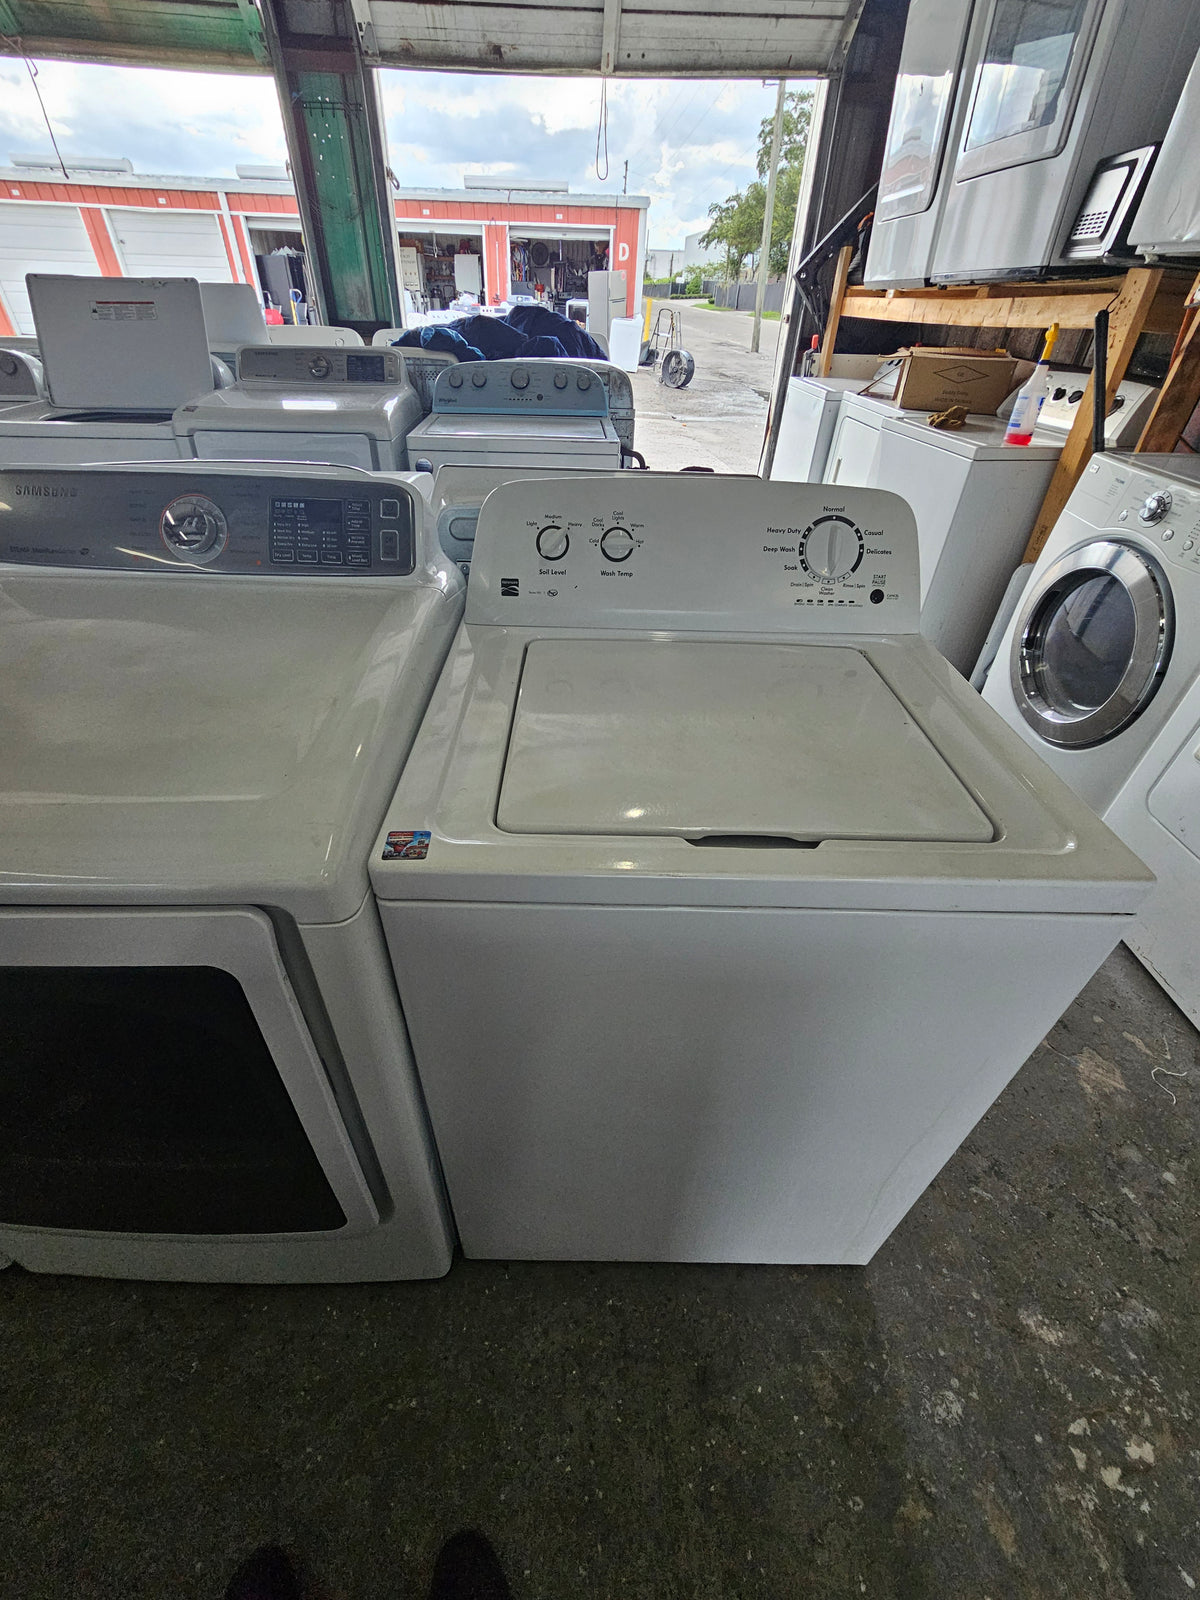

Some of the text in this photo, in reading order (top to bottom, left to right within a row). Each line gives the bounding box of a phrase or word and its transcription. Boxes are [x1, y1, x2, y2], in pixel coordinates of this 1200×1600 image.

[618, 242, 630, 261] D
[15, 484, 79, 497] SAMSUNG
[766, 527, 802, 535] Heavy Duty
[763, 545, 779, 553] Deep
